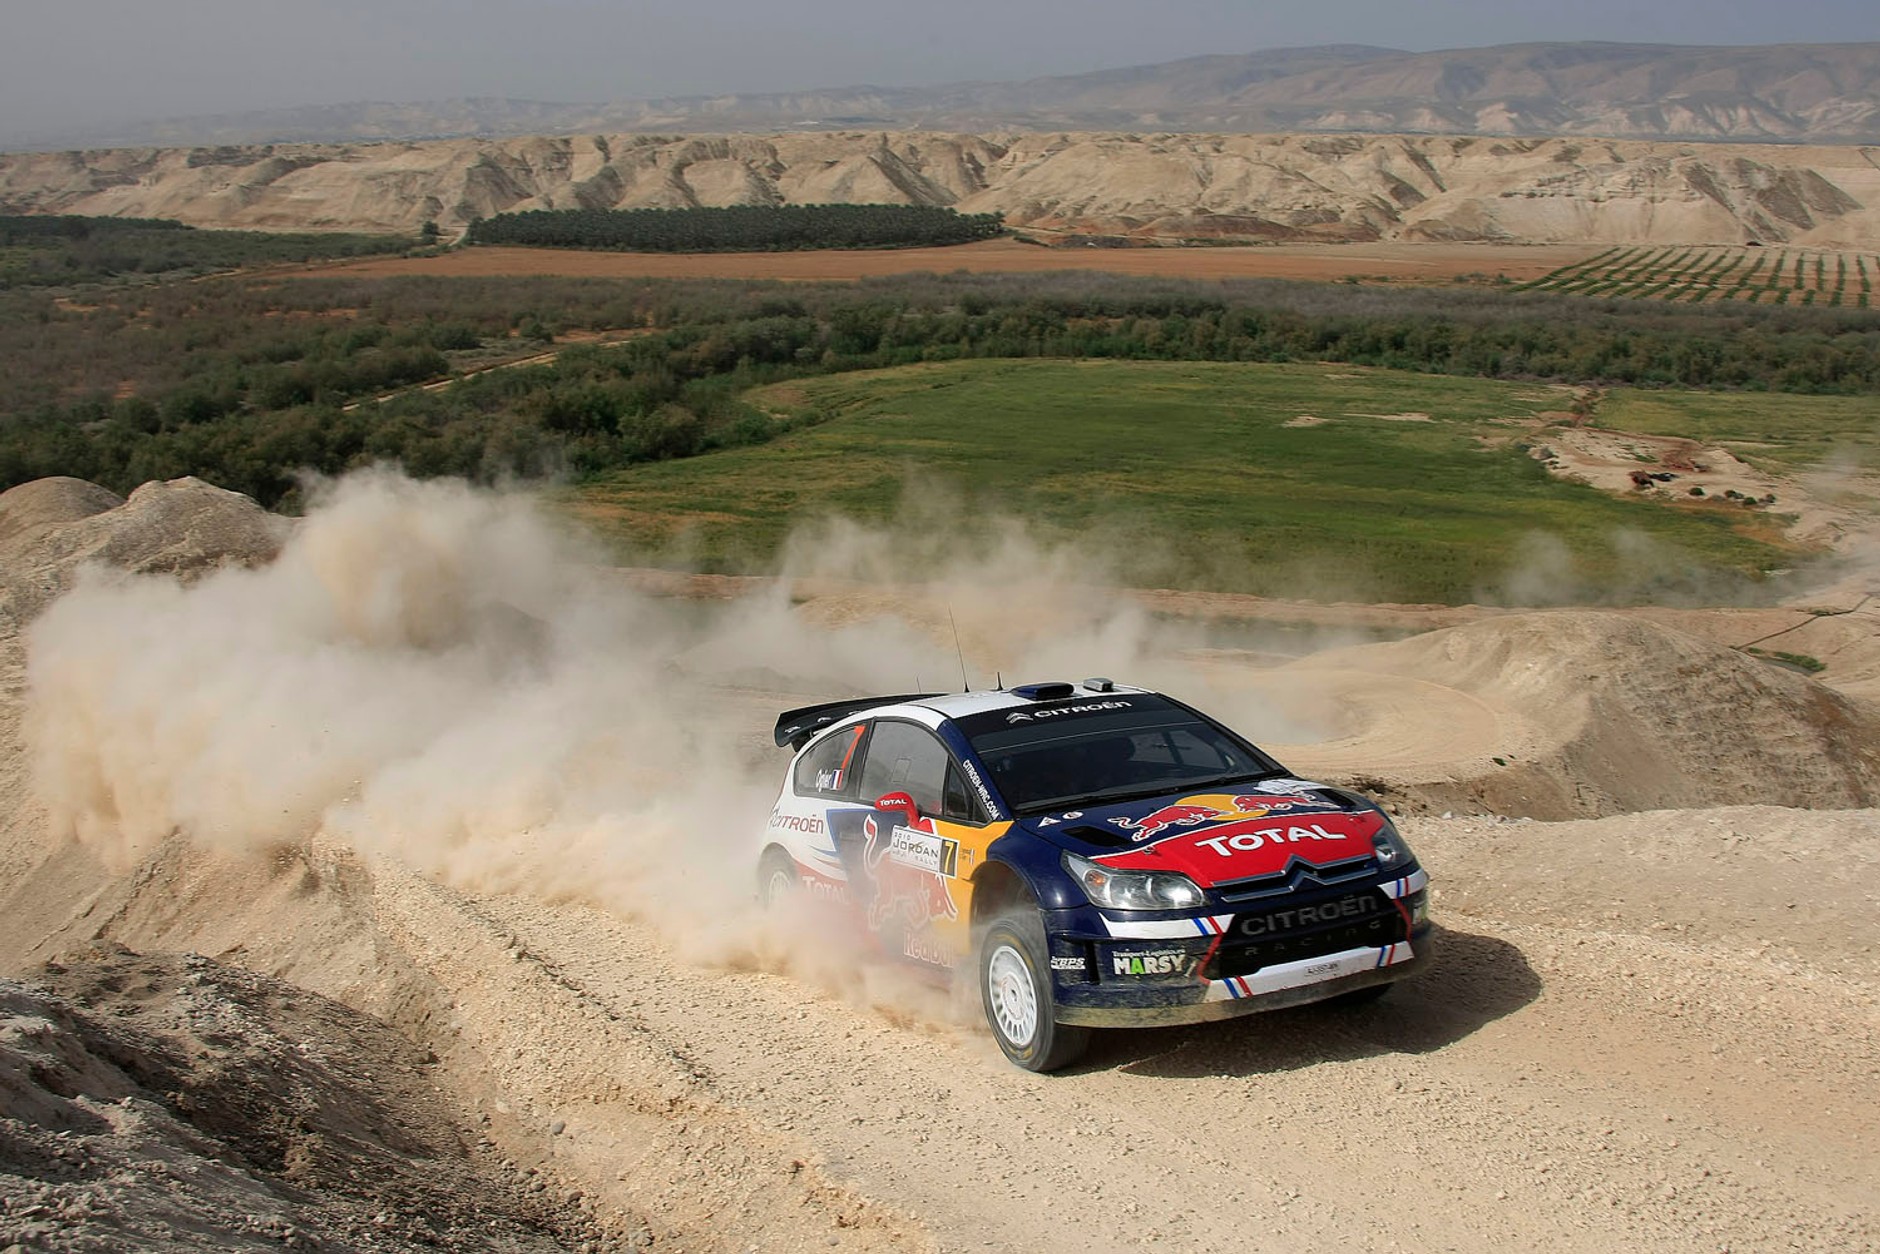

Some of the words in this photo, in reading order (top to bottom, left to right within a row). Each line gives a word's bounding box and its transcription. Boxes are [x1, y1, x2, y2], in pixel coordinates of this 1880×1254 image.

[841, 724, 866, 770] 7
[879, 798, 908, 807] TOTAL
[892, 838, 939, 859] JORDAN
[894, 831, 912, 841] 2010
[1194, 824, 1347, 857] TOTAL
[944, 840, 955, 875] 7
[1240, 893, 1379, 936] CITROËN
[1112, 954, 1187, 976] MARSY
